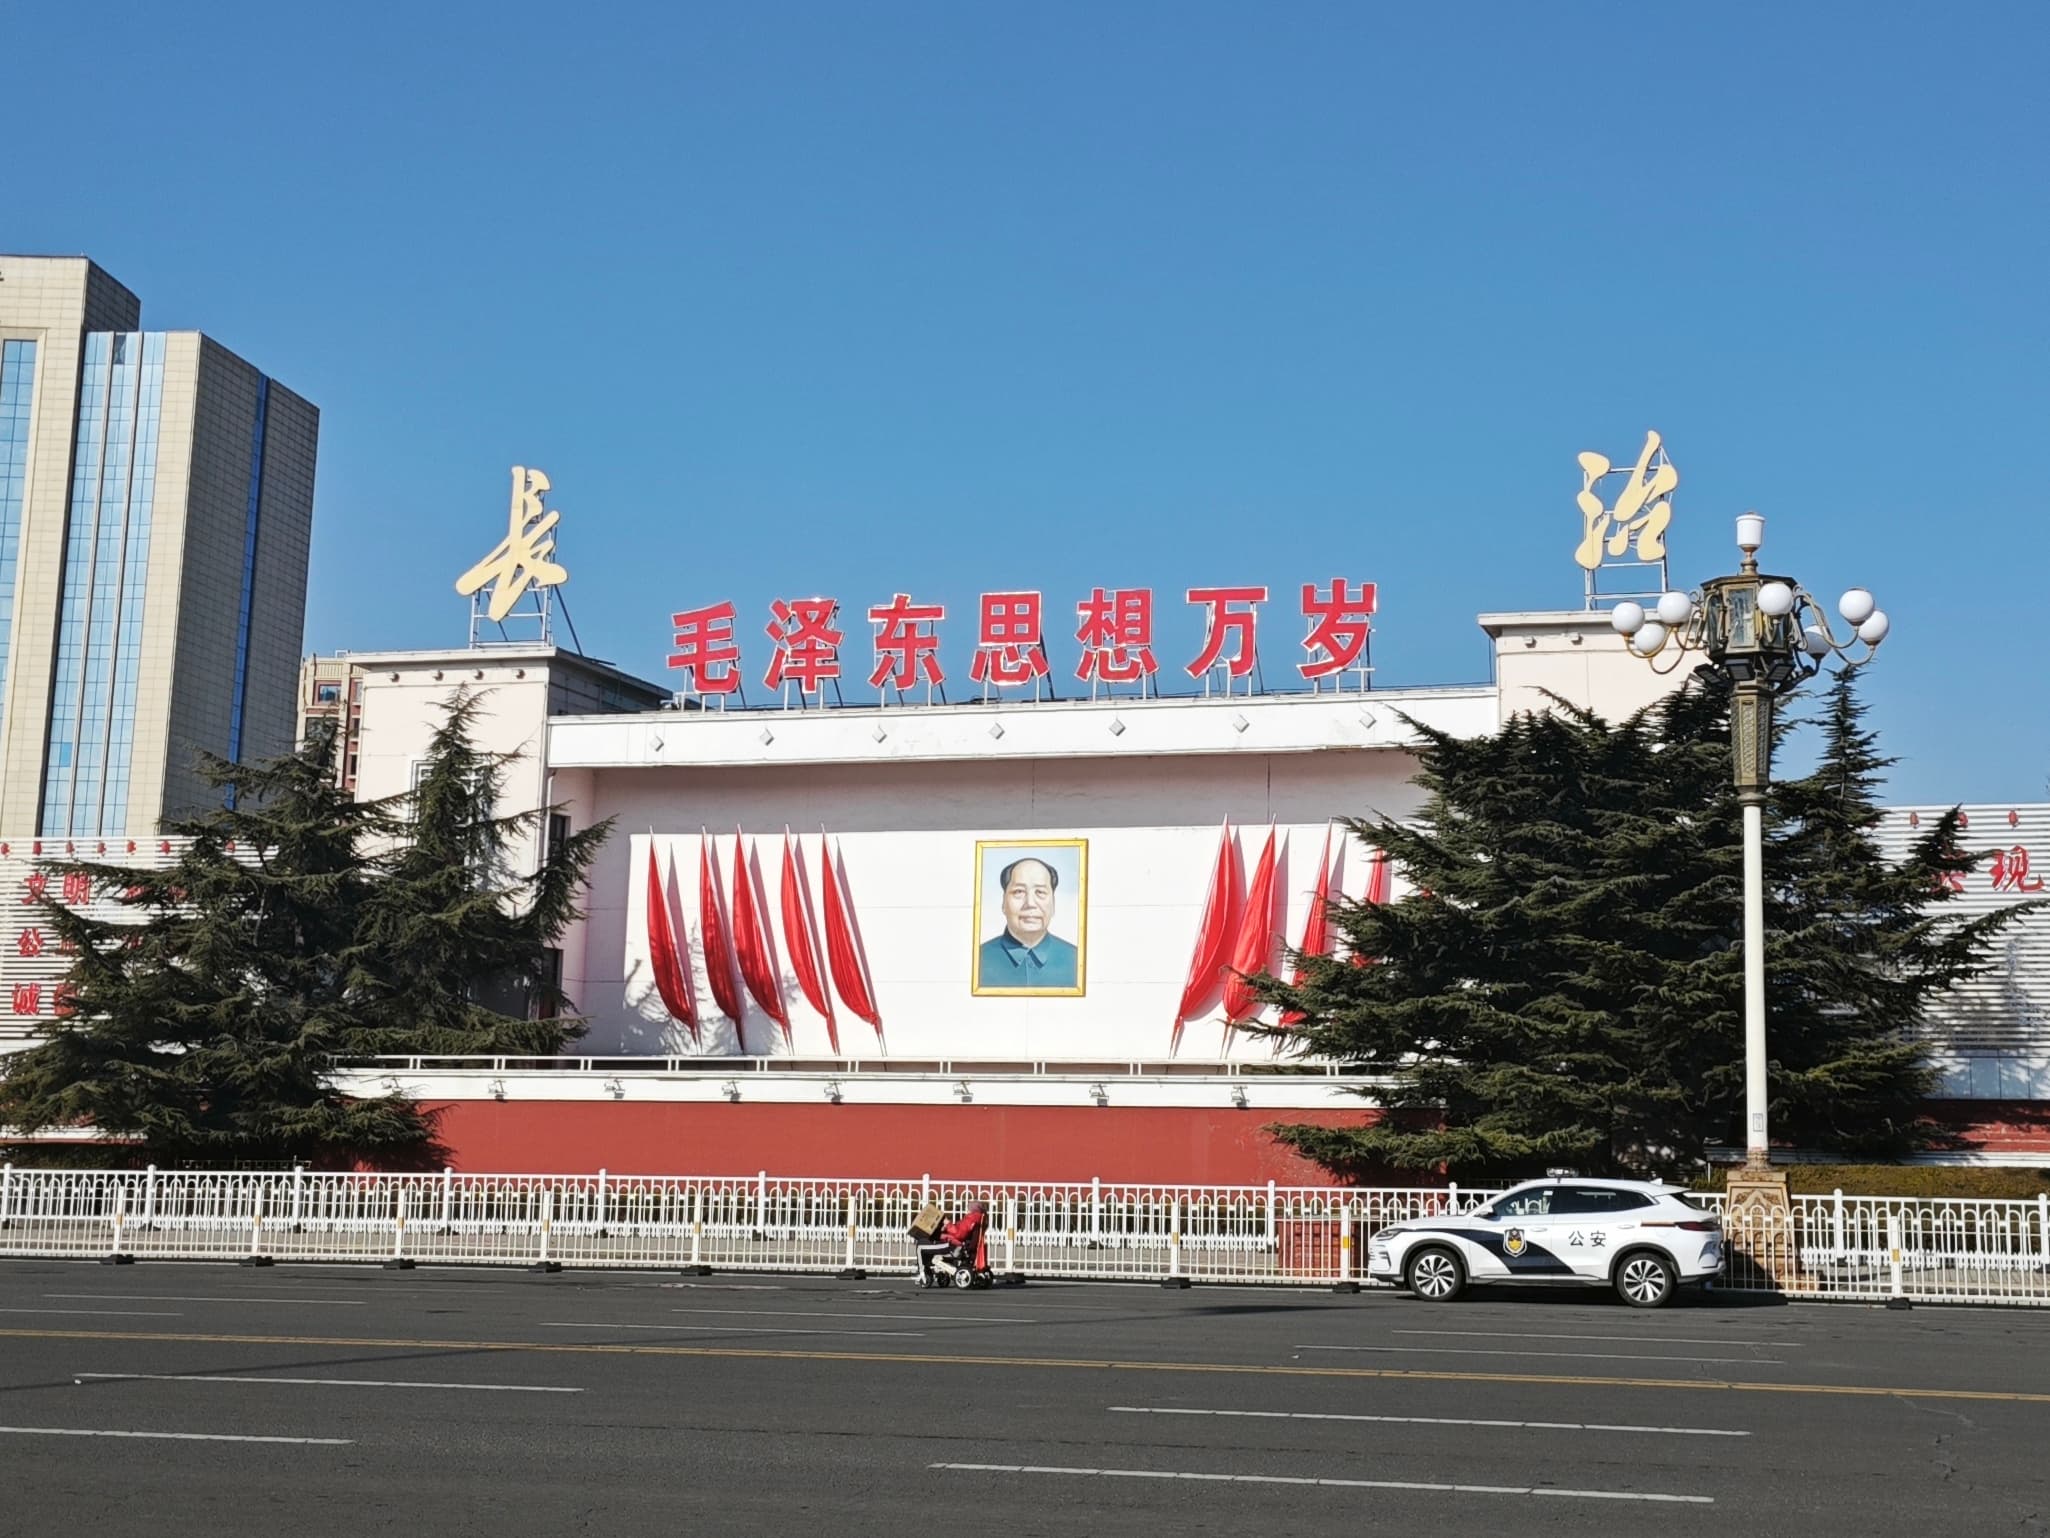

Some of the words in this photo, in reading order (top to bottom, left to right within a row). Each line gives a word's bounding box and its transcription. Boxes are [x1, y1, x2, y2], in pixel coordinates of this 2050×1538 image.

[667, 578, 1378, 694] 毛泽东思想万岁
[20, 871, 91, 905] 文明
[1568, 1230, 1606, 1247] 公安
